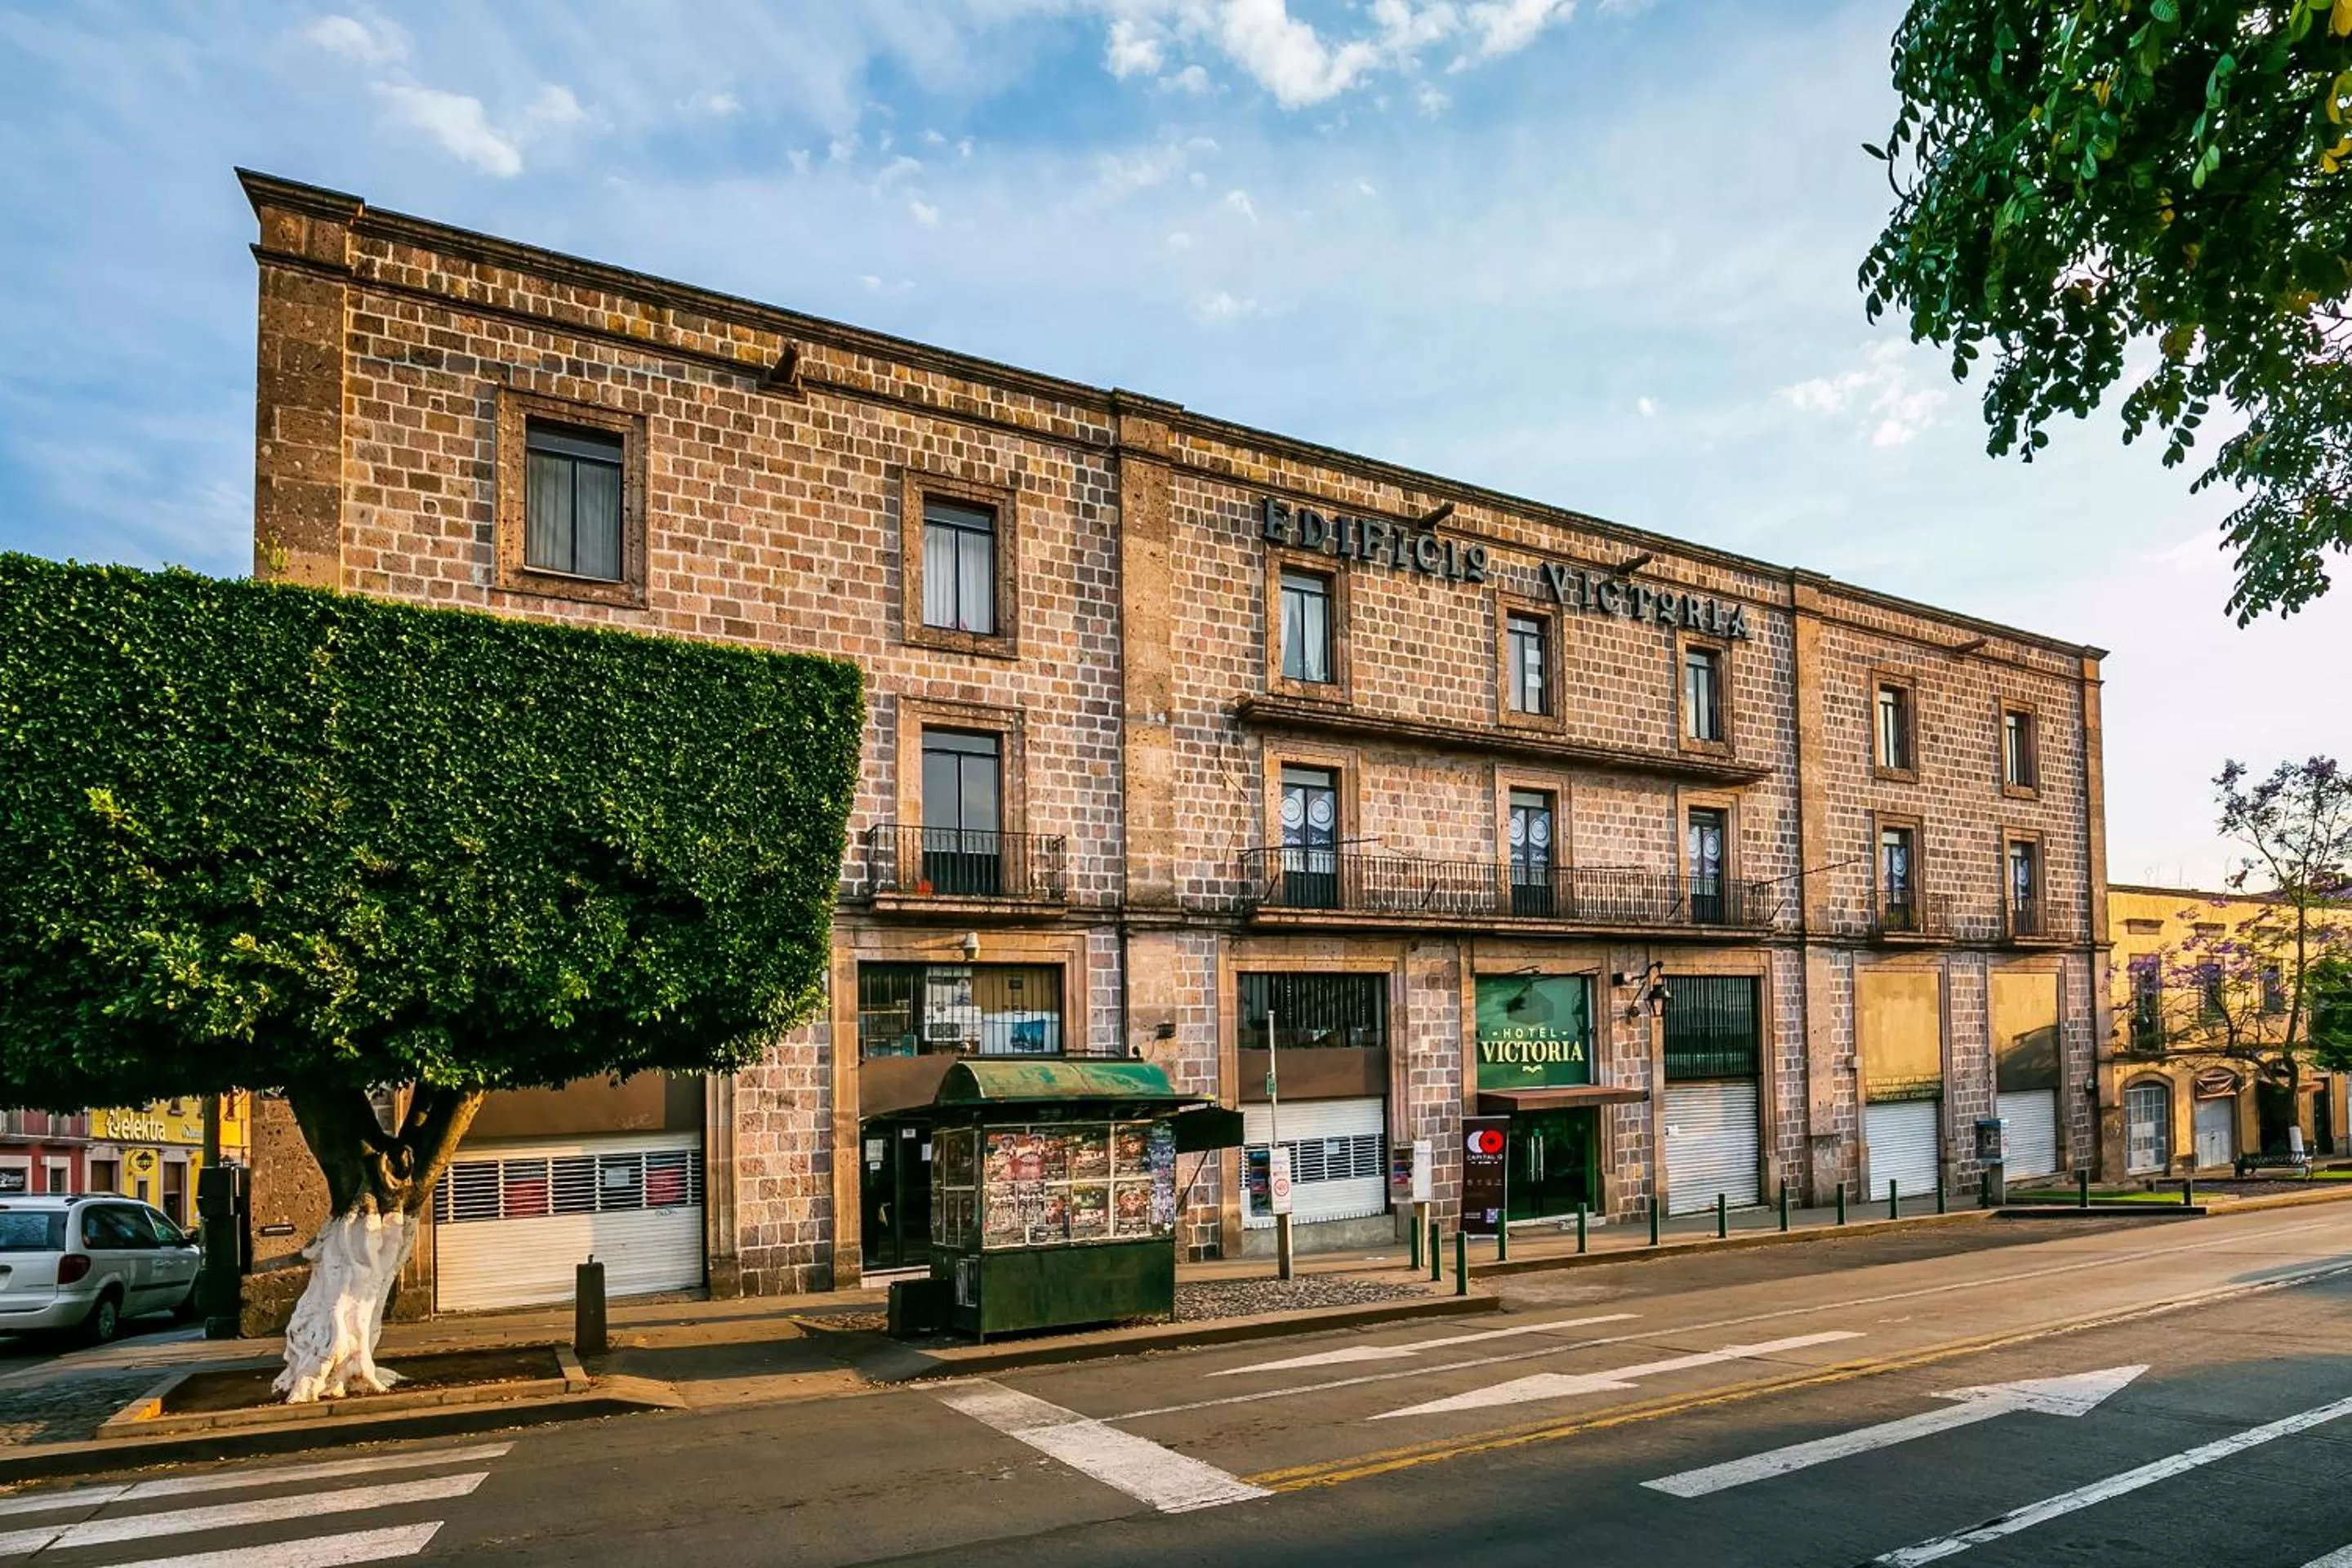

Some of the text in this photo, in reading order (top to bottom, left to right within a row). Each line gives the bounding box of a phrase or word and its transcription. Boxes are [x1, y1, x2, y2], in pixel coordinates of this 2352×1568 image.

[1263, 497, 1753, 639] EDIFICIO VICTORIA
[1503, 1027, 1557, 1039] HOTEL
[1481, 1040, 1584, 1062] VICTORIA
[122, 1111, 166, 1141] elektra
